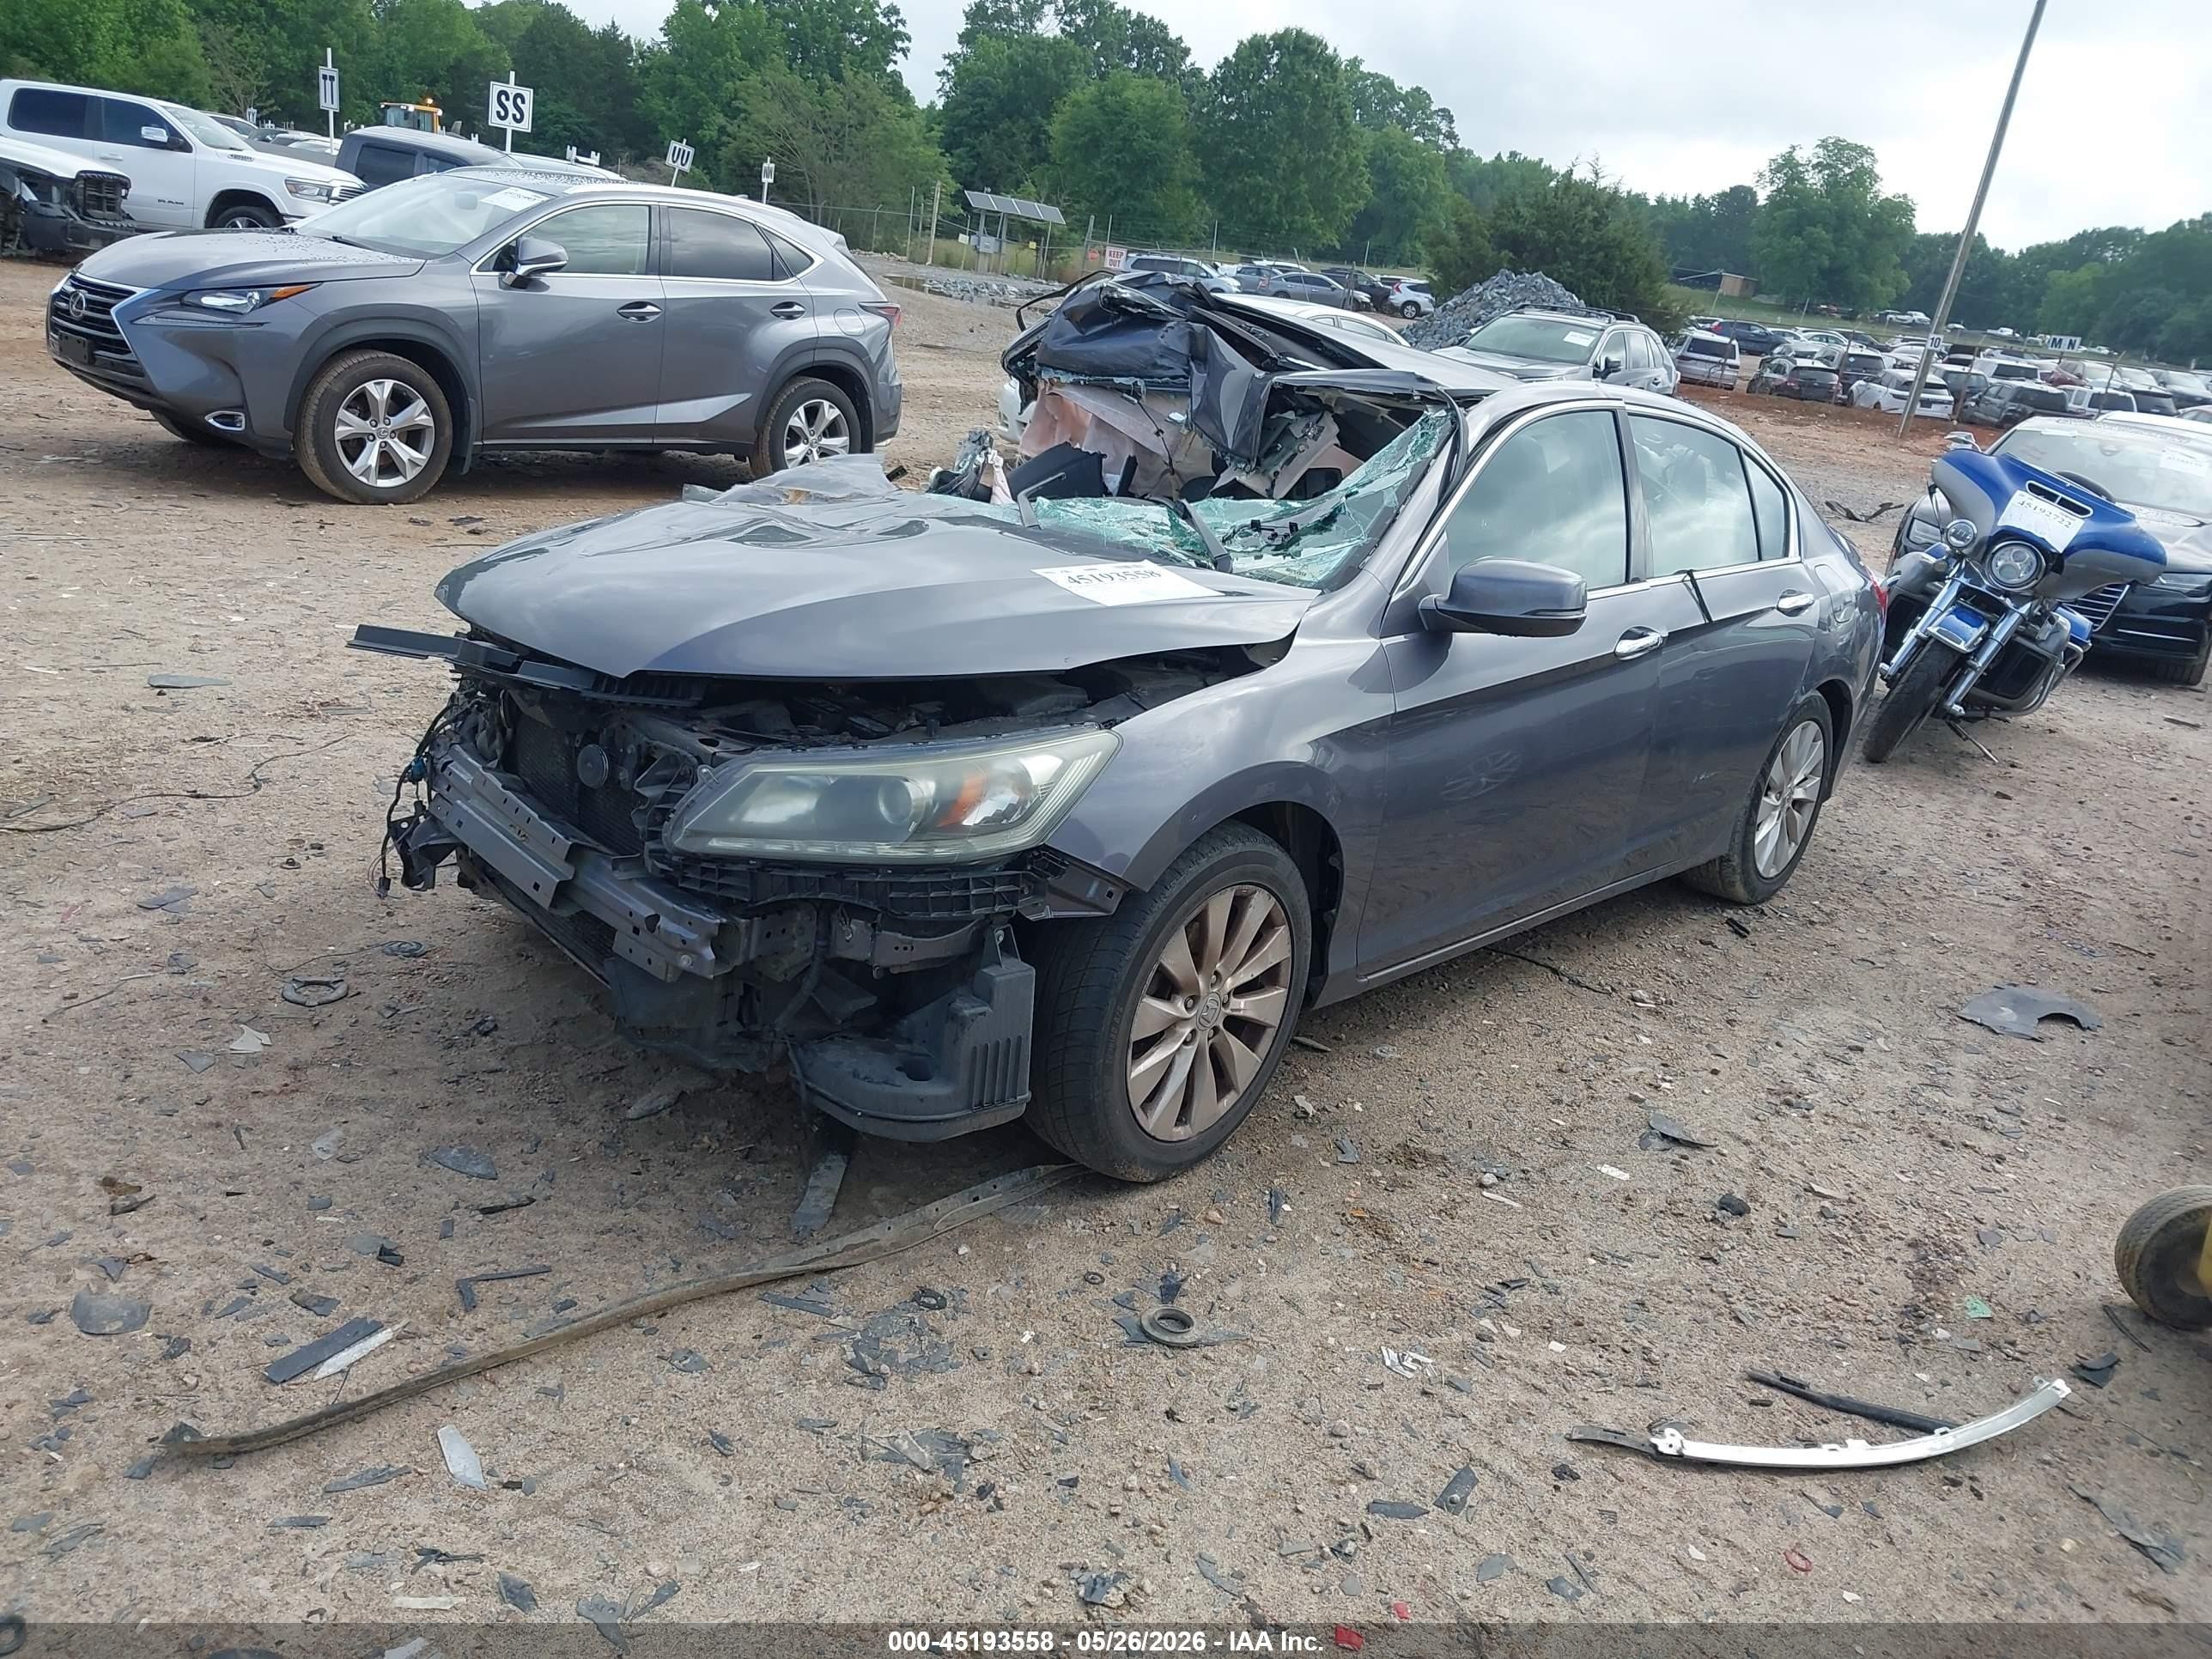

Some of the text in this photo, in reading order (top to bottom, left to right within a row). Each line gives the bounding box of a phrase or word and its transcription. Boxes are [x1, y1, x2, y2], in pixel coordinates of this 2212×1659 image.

[321, 74, 335, 105] TT
[495, 89, 526, 124] SS
[672, 146, 690, 167] UU
[1109, 250, 1124, 259] KEEP
[1109, 259, 1121, 268] OUT
[1930, 337, 1942, 349] 10
[2051, 337, 2077, 350] M N
[1067, 570, 1162, 584] 45193558
